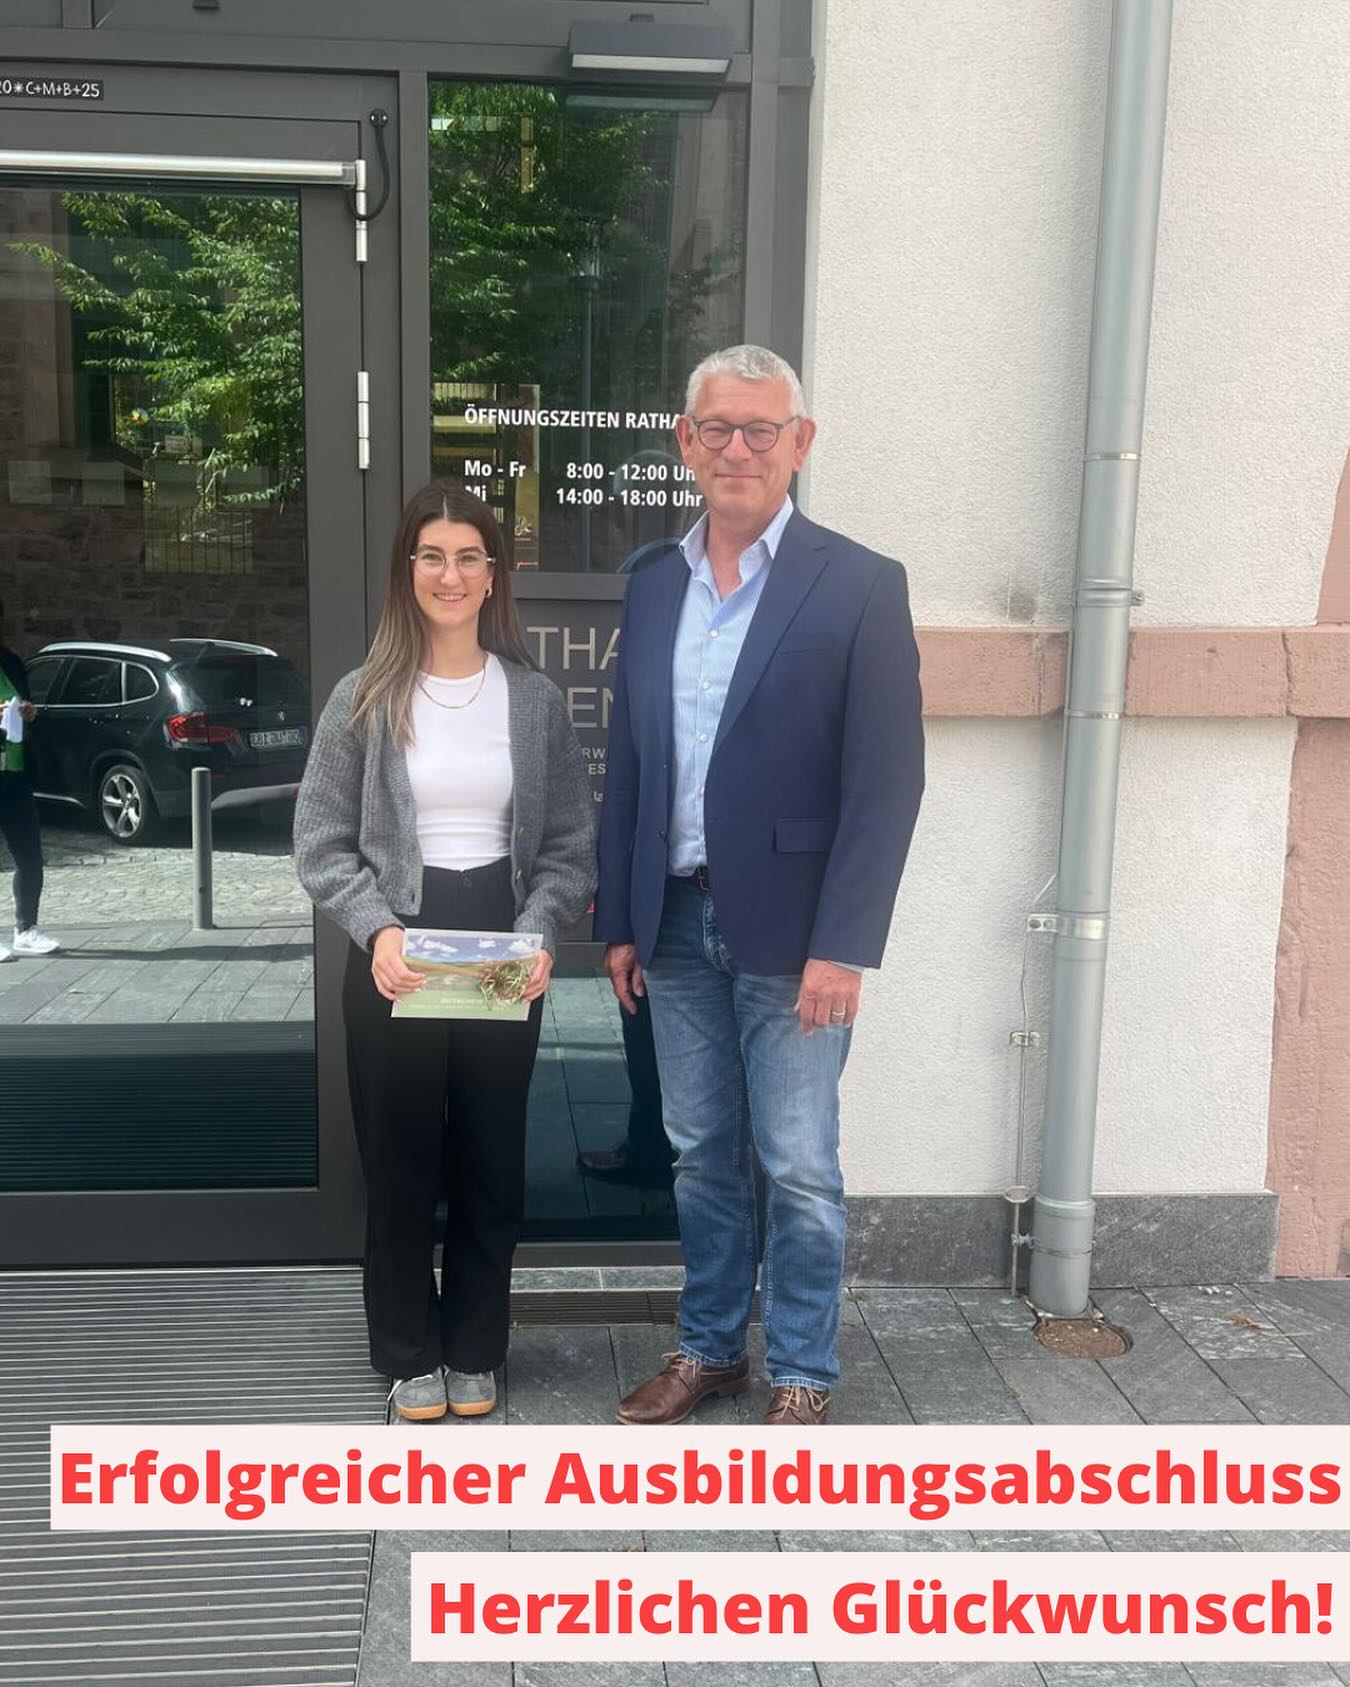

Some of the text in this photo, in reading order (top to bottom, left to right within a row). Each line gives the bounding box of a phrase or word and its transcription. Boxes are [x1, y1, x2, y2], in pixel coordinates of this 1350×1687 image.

[464, 403, 620, 429] ÖFFNUNGSZEITEN
[464, 460, 492, 477] Mo
[509, 461, 527, 478] Fr
[566, 462, 604, 480] 8:00
[621, 463, 668, 482] 12:00
[556, 488, 604, 506] 14:00
[620, 489, 667, 507] 18:00
[673, 490, 703, 507] Uhr
